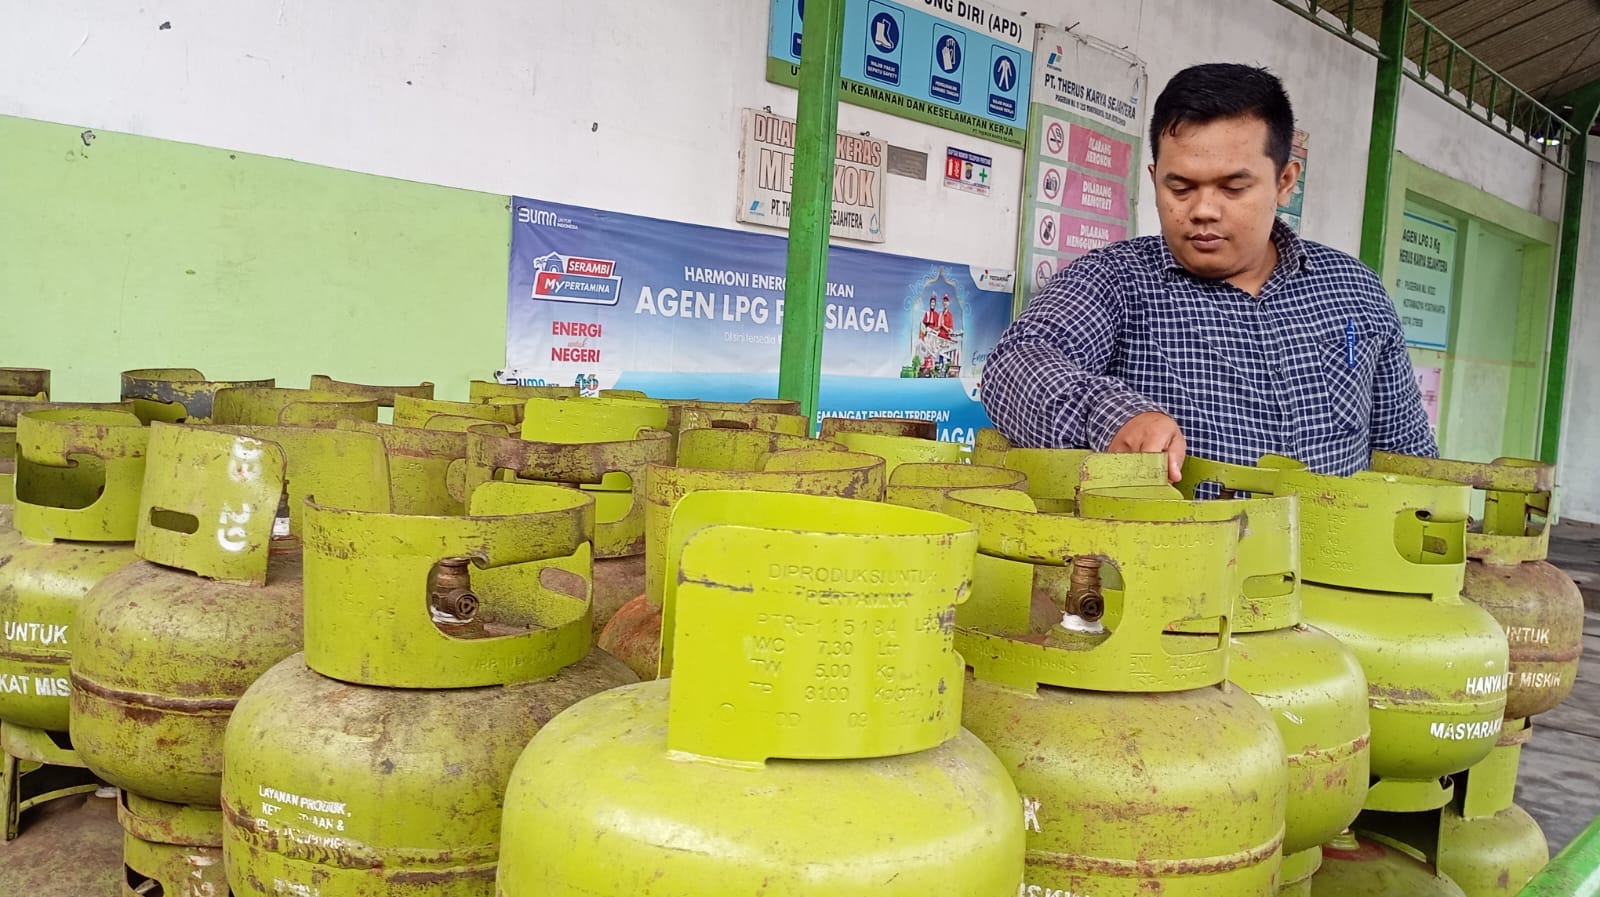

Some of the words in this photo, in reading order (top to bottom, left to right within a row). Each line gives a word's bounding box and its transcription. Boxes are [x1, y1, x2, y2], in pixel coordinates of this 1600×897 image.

[957, 1, 985, 26] DIRI
[988, 13, 1023, 43] (APD)
[1044, 73, 1056, 89] PT.
[1058, 77, 1085, 99] THERUS
[1086, 87, 1107, 108] KARYA
[850, 85, 903, 107] KEAMANAN
[906, 99, 925, 112] DAN
[927, 104, 987, 129] KESELAMATAN
[988, 121, 1014, 137] KERJA
[836, 134, 882, 167] KERAS
[771, 199, 782, 217] PT.
[568, 260, 611, 275] SERAMBI
[684, 266, 749, 288] HARMONI
[825, 283, 854, 298] IKAN
[634, 286, 715, 320] AGEN
[722, 294, 769, 325] LPG
[825, 303, 889, 333] SIAGA
[552, 321, 603, 337] ENERGI
[551, 347, 601, 363] NEGERI
[816, 410, 868, 424] EMANGAT
[5, 621, 69, 645] UNTUK
[818, 639, 854, 656] 7.30
[815, 663, 852, 680] 5.00
[1520, 672, 1561, 688] MISKIN
[0, 675, 29, 695] KAT
[35, 676, 71, 697] MIS
[1466, 674, 1501, 695] HANYA
[259, 784, 300, 807] LAYANAN
[336, 819, 345, 832] &
